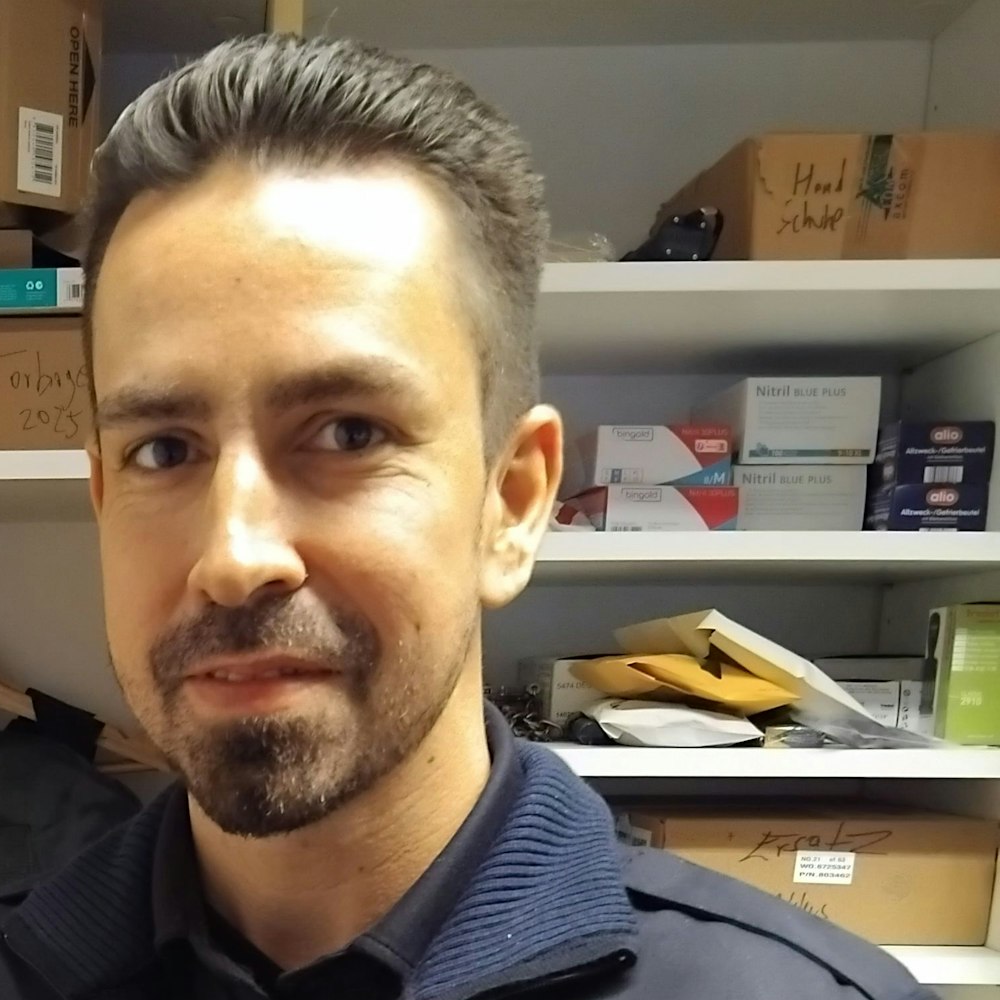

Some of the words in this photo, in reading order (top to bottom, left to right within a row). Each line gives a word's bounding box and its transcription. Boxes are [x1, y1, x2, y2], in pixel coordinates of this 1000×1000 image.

[68, 26, 81, 75] OPEN
[67, 80, 79, 128] HERE
[756, 385, 791, 397] Nitril
[793, 387, 819, 397] BLUE
[821, 387, 847, 397] PLUS
[18, 405, 83, 439] 2025
[616, 429, 650, 440] bingold
[742, 473, 776, 485] Nitril
[779, 476, 804, 485] BLUE
[807, 475, 832, 485] PLUS
[625, 490, 658, 501] bingold
